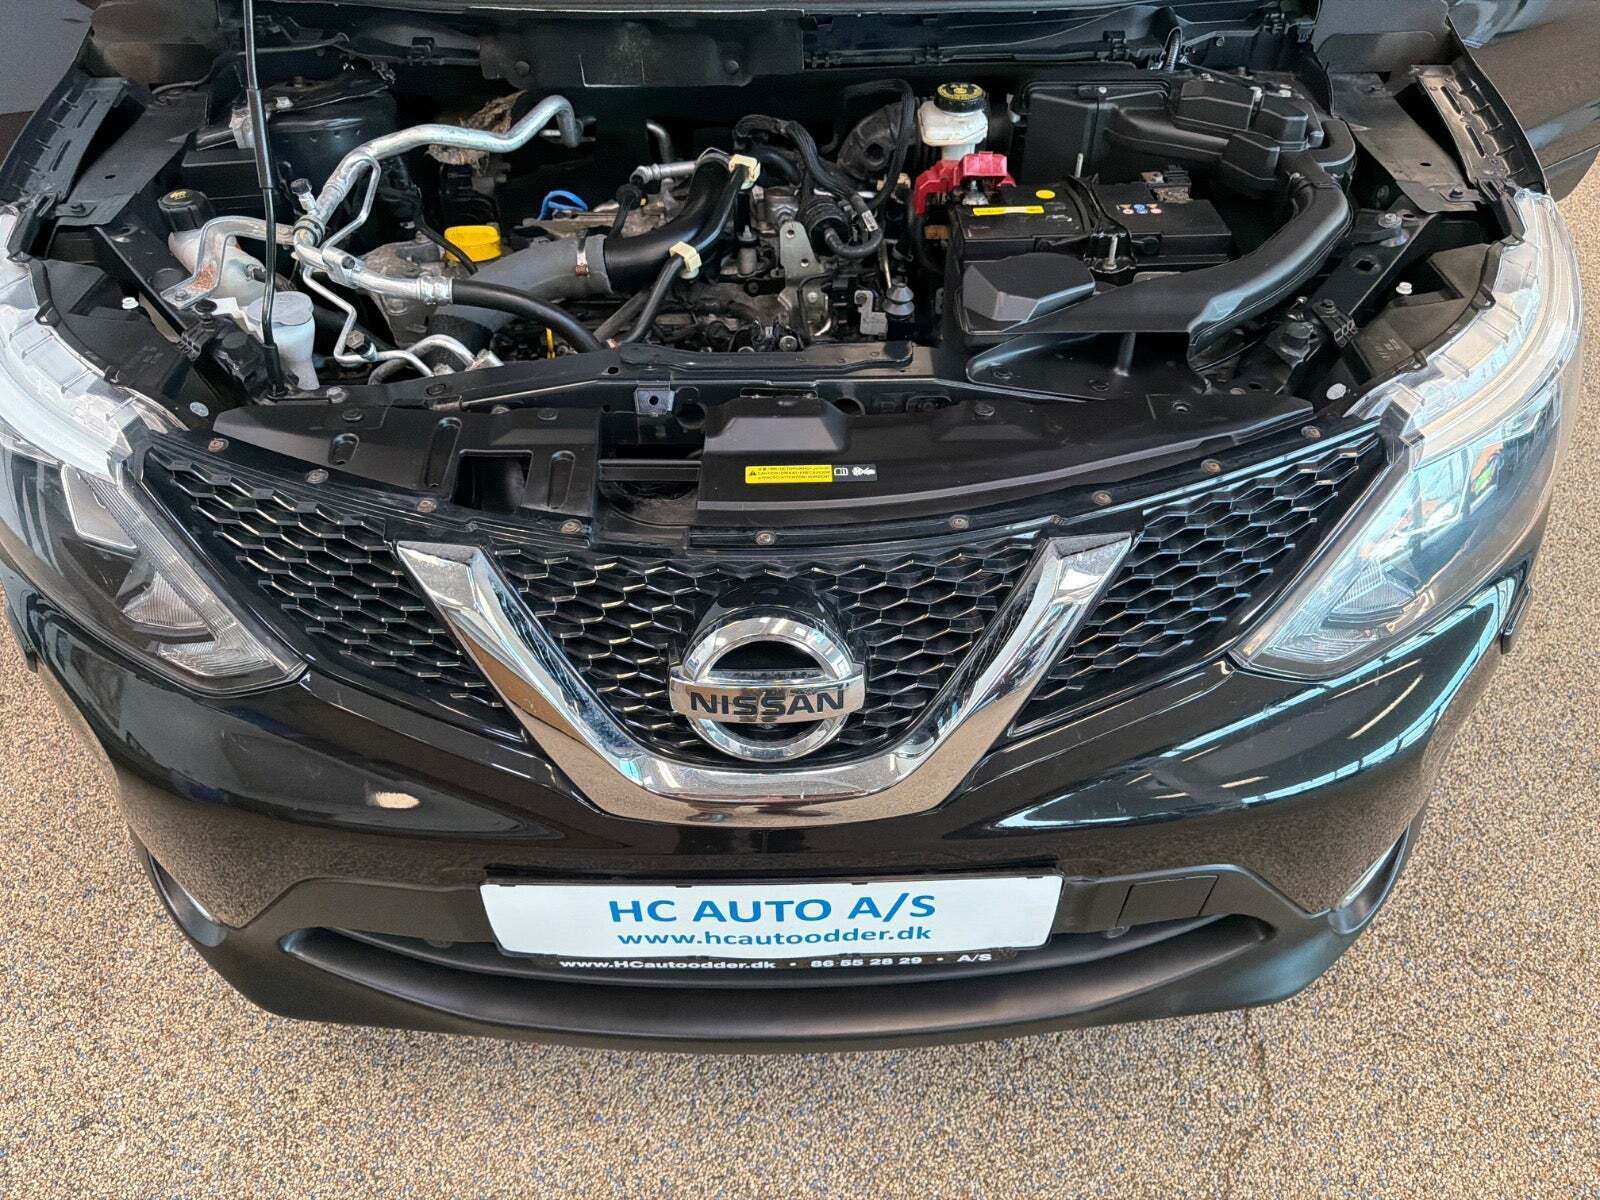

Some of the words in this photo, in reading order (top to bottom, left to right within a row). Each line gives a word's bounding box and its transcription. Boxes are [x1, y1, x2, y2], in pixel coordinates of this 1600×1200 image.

[690, 690, 844, 716] NISSAN
[608, 900, 677, 922] HC
[693, 898, 832, 922] AUTO
[847, 892, 936, 922] A/S
[617, 926, 932, 945] www.hcautoodder.dk
[559, 960, 777, 969] www.HCautoodder.dk
[840, 959, 863, 967] 55
[869, 957, 893, 966] 28
[898, 957, 922, 965] 29
[957, 953, 991, 963] A/S
